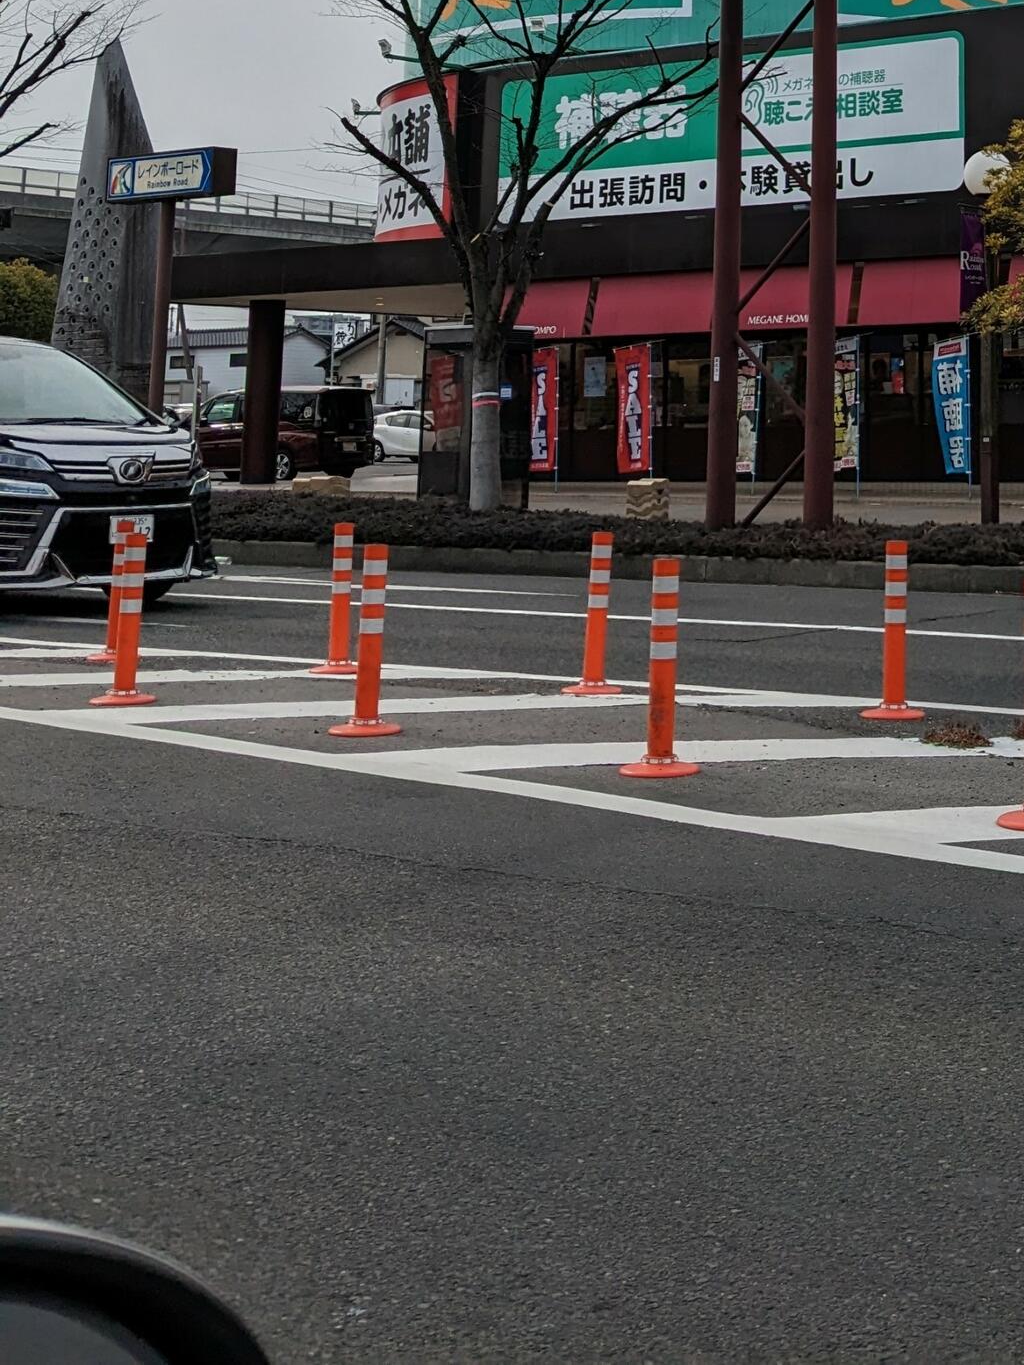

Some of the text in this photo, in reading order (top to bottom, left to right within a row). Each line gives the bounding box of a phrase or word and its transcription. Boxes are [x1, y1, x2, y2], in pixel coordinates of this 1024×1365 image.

[555, 84, 689, 150] 補聴器
[146, 178, 189, 188] Rainbow Road
[747, 314, 784, 325] MEGANE
[531, 372, 548, 460] SALE
[624, 370, 642, 460] SALE
